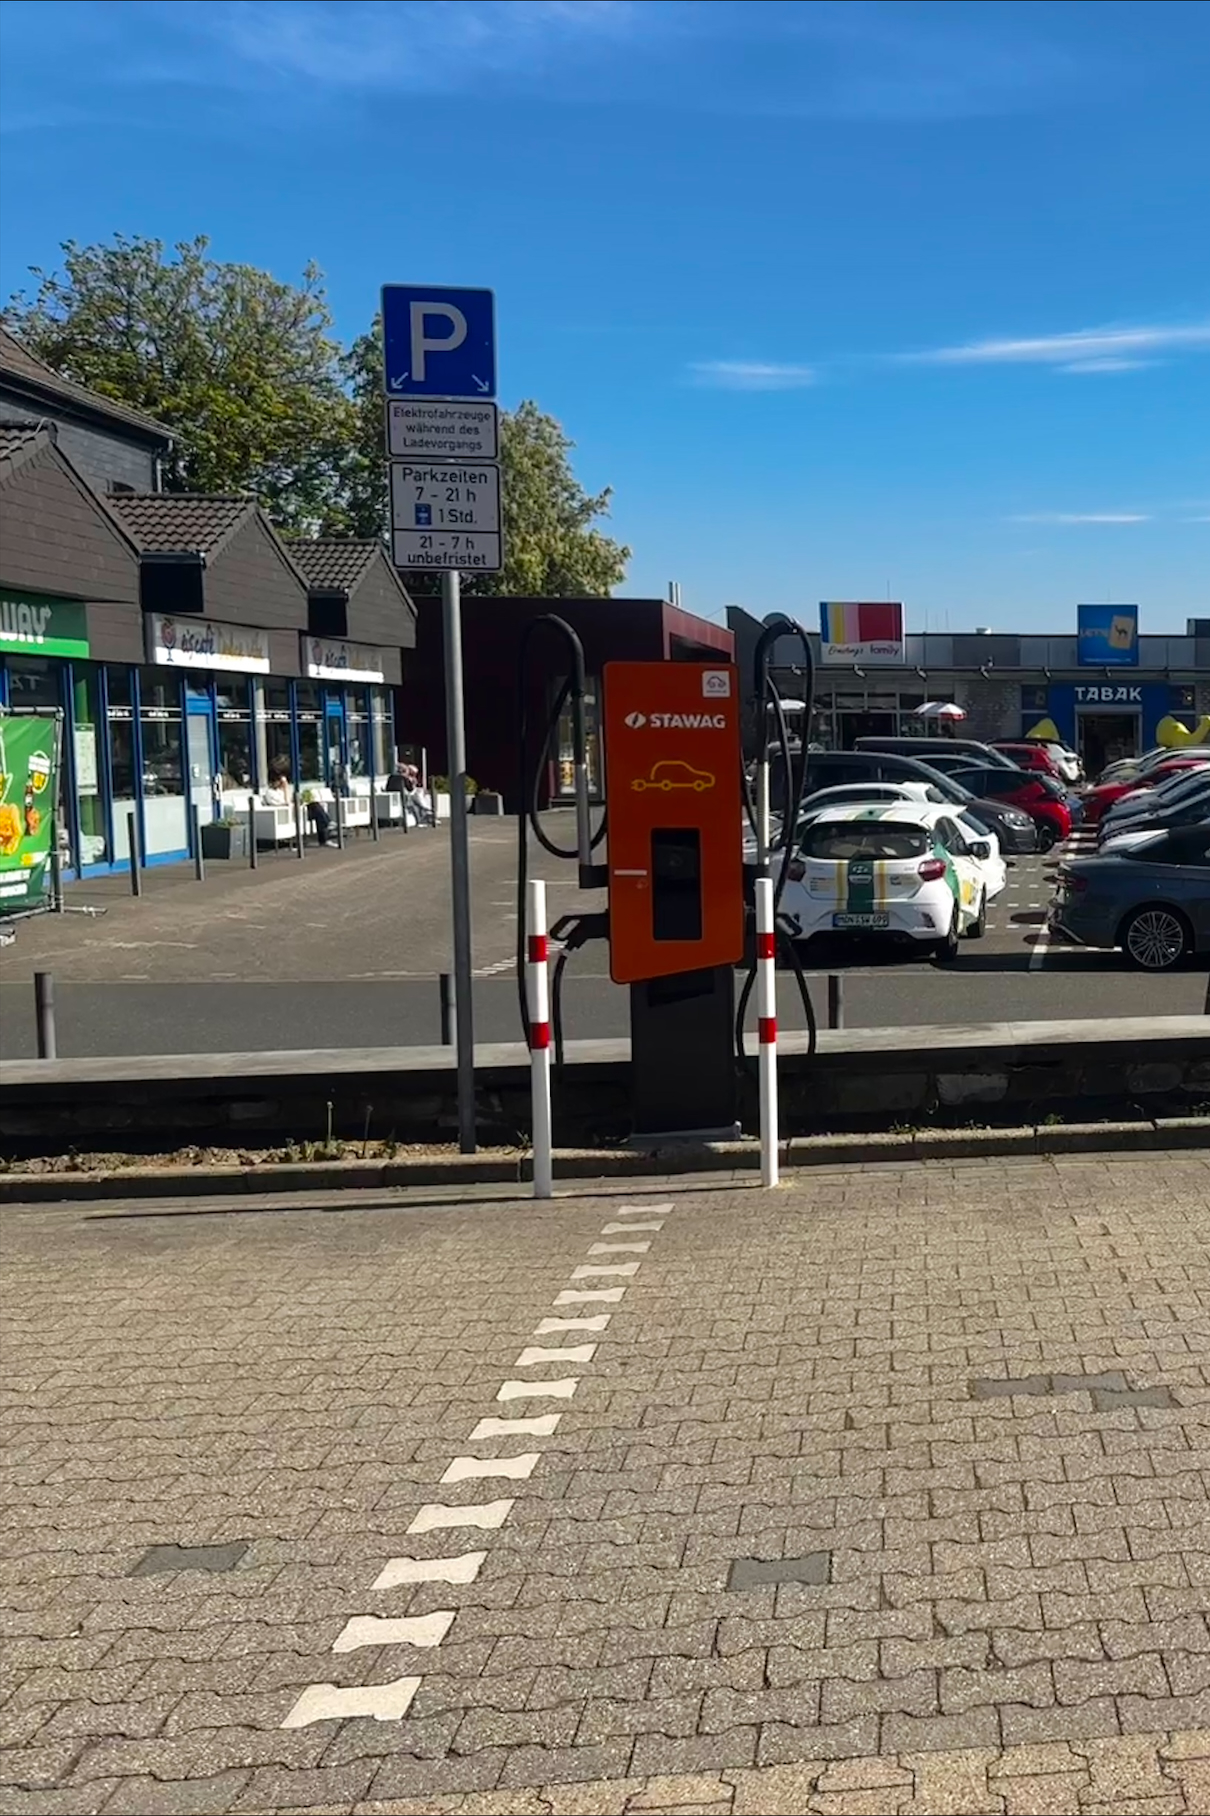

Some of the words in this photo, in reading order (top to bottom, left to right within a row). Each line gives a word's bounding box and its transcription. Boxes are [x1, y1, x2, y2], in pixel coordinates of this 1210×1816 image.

[410, 301, 468, 382] P
[393, 406, 491, 421] Elektrofahrzeuge
[406, 422, 455, 435] während
[459, 424, 480, 435] des
[403, 438, 482, 451] Ladevorgangs
[403, 467, 488, 484] Parkzeiten
[415, 486, 424, 500] 7
[445, 487, 460, 502] 21
[466, 488, 476, 502] h
[448, 509, 478, 524] Std.
[419, 535, 433, 549] 21
[451, 536, 460, 549] 7
[466, 537, 475, 550] h
[407, 551, 487, 566] unbefristet
[870, 644, 899, 657] family
[1074, 686, 1142, 701] TABAK
[650, 713, 726, 729] STAWAG
